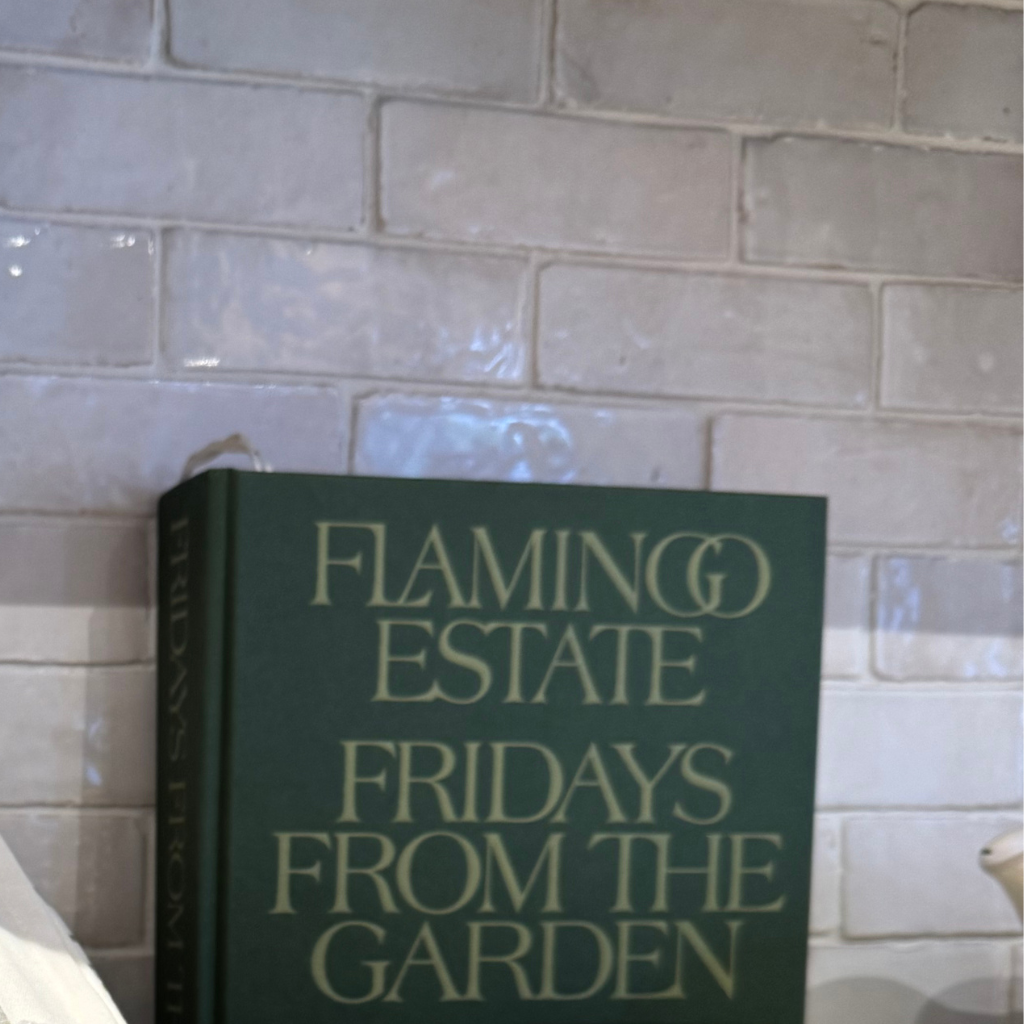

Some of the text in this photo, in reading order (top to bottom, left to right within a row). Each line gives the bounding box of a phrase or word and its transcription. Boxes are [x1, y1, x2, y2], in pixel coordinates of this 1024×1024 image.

[309, 520, 774, 620] FLAMINGO
[167, 515, 190, 762] FRIDAYS
[370, 618, 707, 708] ESTATE
[335, 739, 734, 826] FRIDAYS
[166, 781, 189, 950] FROM
[270, 831, 786, 916] FROM THE
[309, 919, 745, 1004] GARDEN
